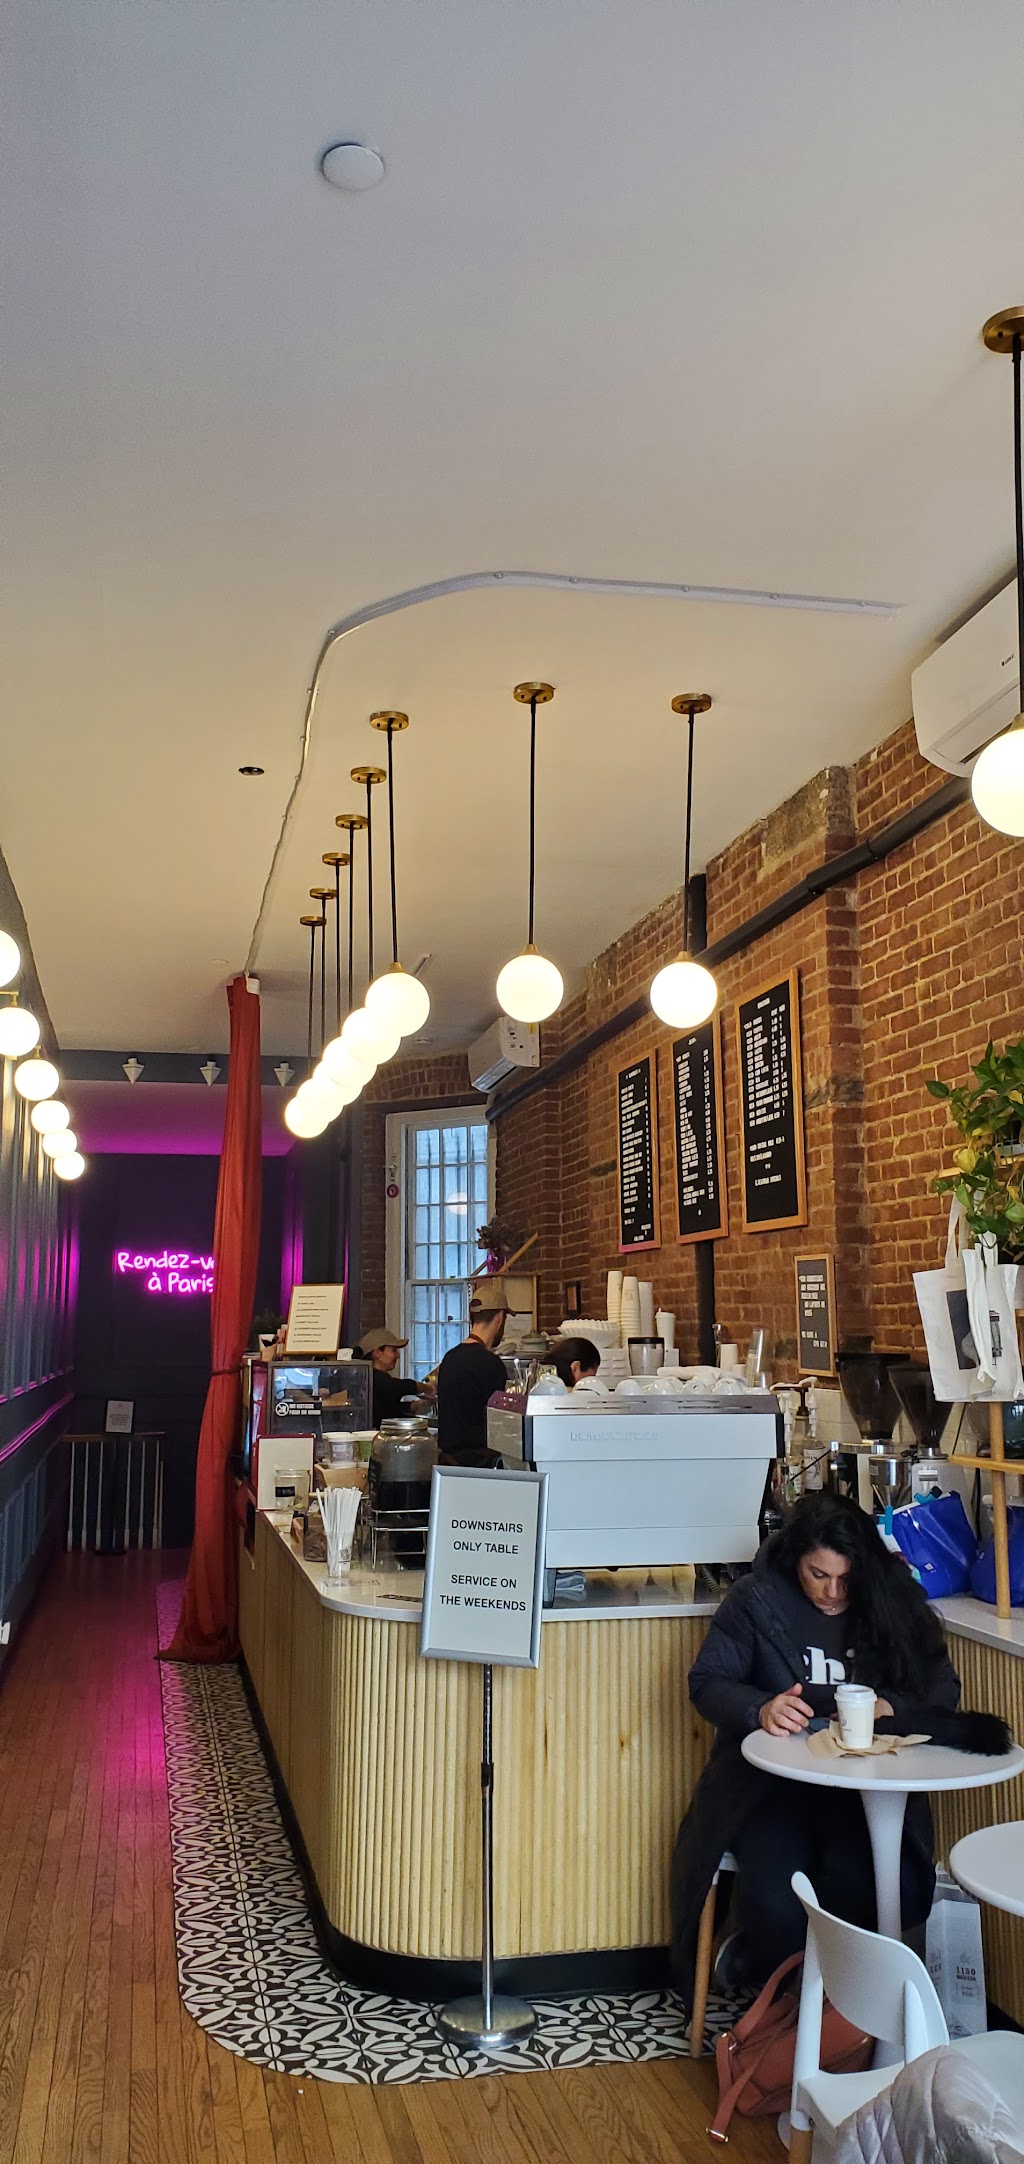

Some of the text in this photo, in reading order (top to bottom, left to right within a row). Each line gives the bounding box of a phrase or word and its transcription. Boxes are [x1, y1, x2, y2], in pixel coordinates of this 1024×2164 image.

[147, 1271, 214, 1293] à Paris
[451, 1519, 523, 1534] DOWNSTAIRS
[453, 1540, 519, 1555] ONLY TABLE
[450, 1574, 517, 1589] SERVICE ON
[439, 1594, 526, 1611] THE WEEKENDS
